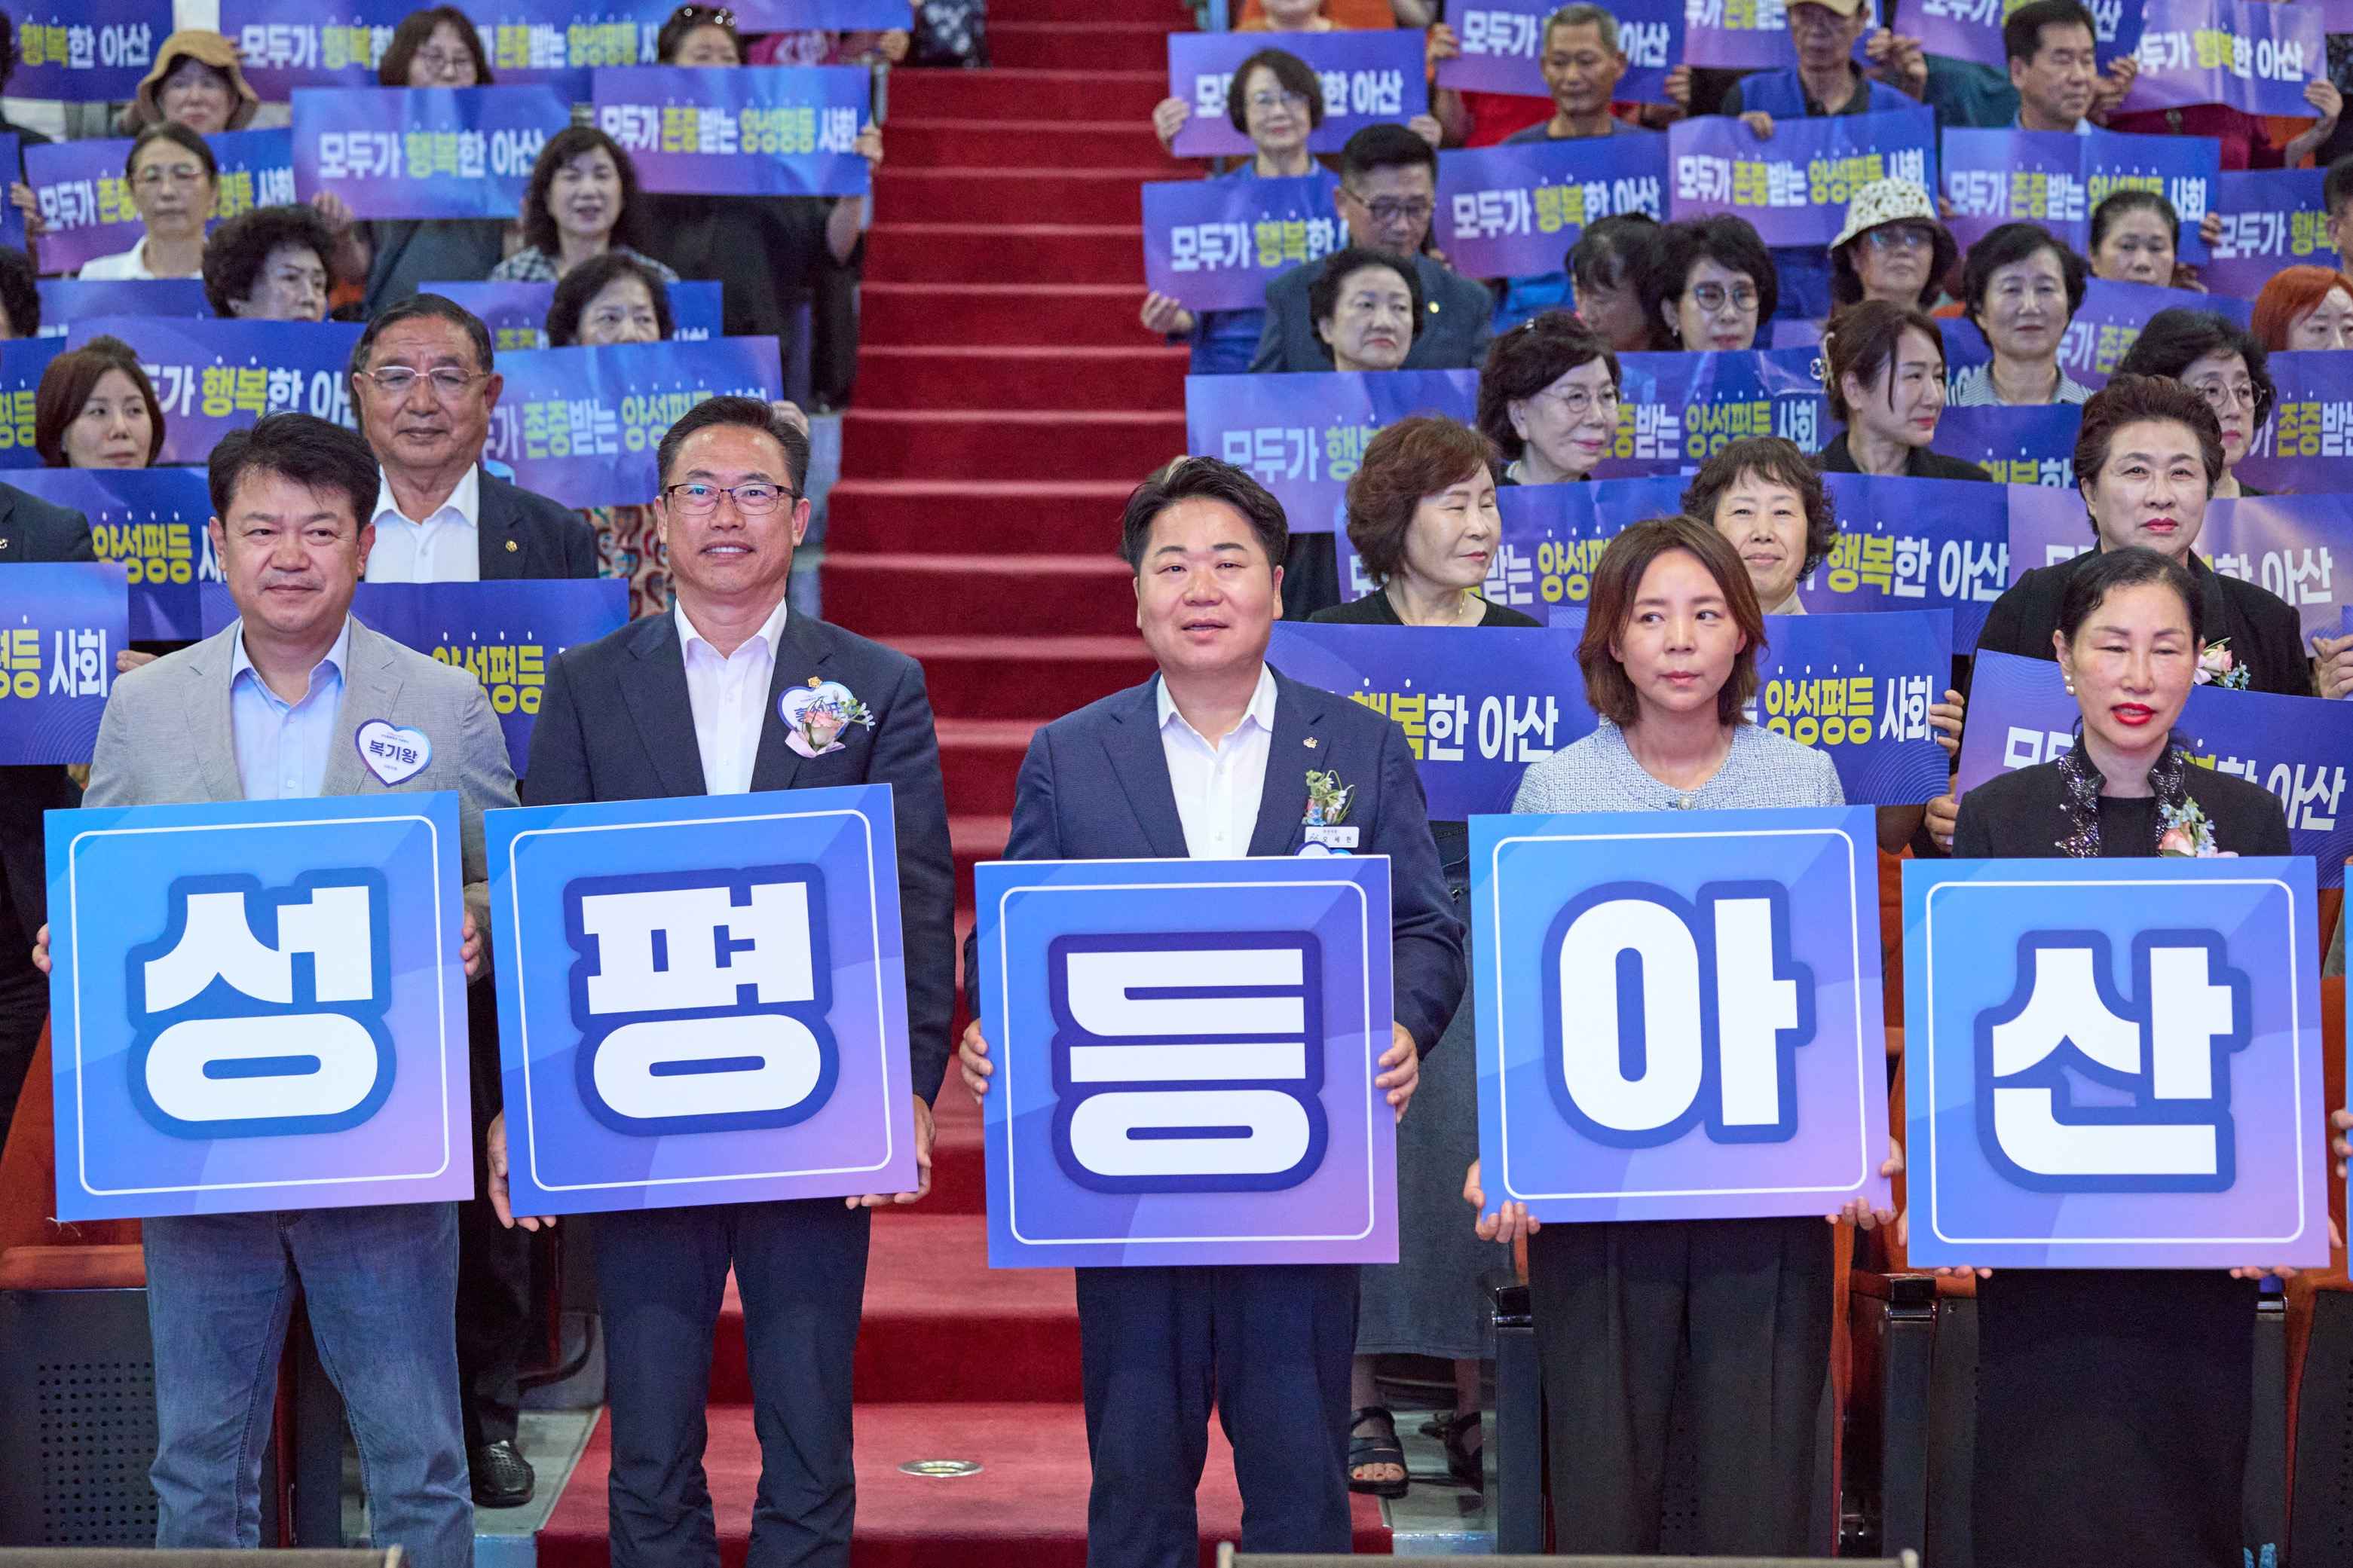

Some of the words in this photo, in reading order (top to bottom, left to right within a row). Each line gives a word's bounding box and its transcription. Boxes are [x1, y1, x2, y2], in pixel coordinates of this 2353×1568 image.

[20, 23, 96, 69] 행복한
[99, 23, 150, 68] 아산
[241, 24, 318, 70] 모두가
[496, 23, 566, 69] 존중받는
[1460, 10, 1538, 59] 모두가
[1620, 21, 1669, 68] 아산
[2193, 28, 2254, 79] 행복한
[2256, 38, 2304, 82] 아산
[1351, 69, 1404, 115] 아산
[319, 130, 402, 180] 모두가
[405, 128, 488, 179] 행복한
[601, 104, 661, 152] 모두가
[662, 106, 738, 154] 존중받는
[739, 106, 817, 154] 양성평등
[38, 179, 98, 231] 모두가
[1452, 188, 1532, 239] 모두가
[1534, 179, 1611, 233] 행복한
[1677, 154, 1731, 205] 모두가
[1733, 159, 1807, 207] 존중받는
[1949, 170, 2008, 219] 모두가
[2012, 171, 2086, 222] 존중받는
[1170, 222, 1252, 271] 모두가
[2211, 210, 2287, 259] 모두가
[201, 365, 304, 417] 행복한
[522, 396, 620, 460] 존중받는
[1222, 426, 1319, 484] 모두가
[1605, 402, 1681, 460] 중받는
[1827, 531, 1932, 600] 행복한
[1938, 539, 2010, 603] 아산
[2261, 546, 2333, 606] 아산
[1477, 694, 1559, 763] 아산
[1764, 677, 1875, 746] 양성평등
[369, 739, 418, 764] 복기왕
[2266, 763, 2347, 833] 아산
[145, 885, 378, 1122] 성
[581, 881, 822, 1119] 평
[1559, 897, 1798, 1132] 아
[1066, 948, 1310, 1177] 등
[1992, 946, 2233, 1175] 산
